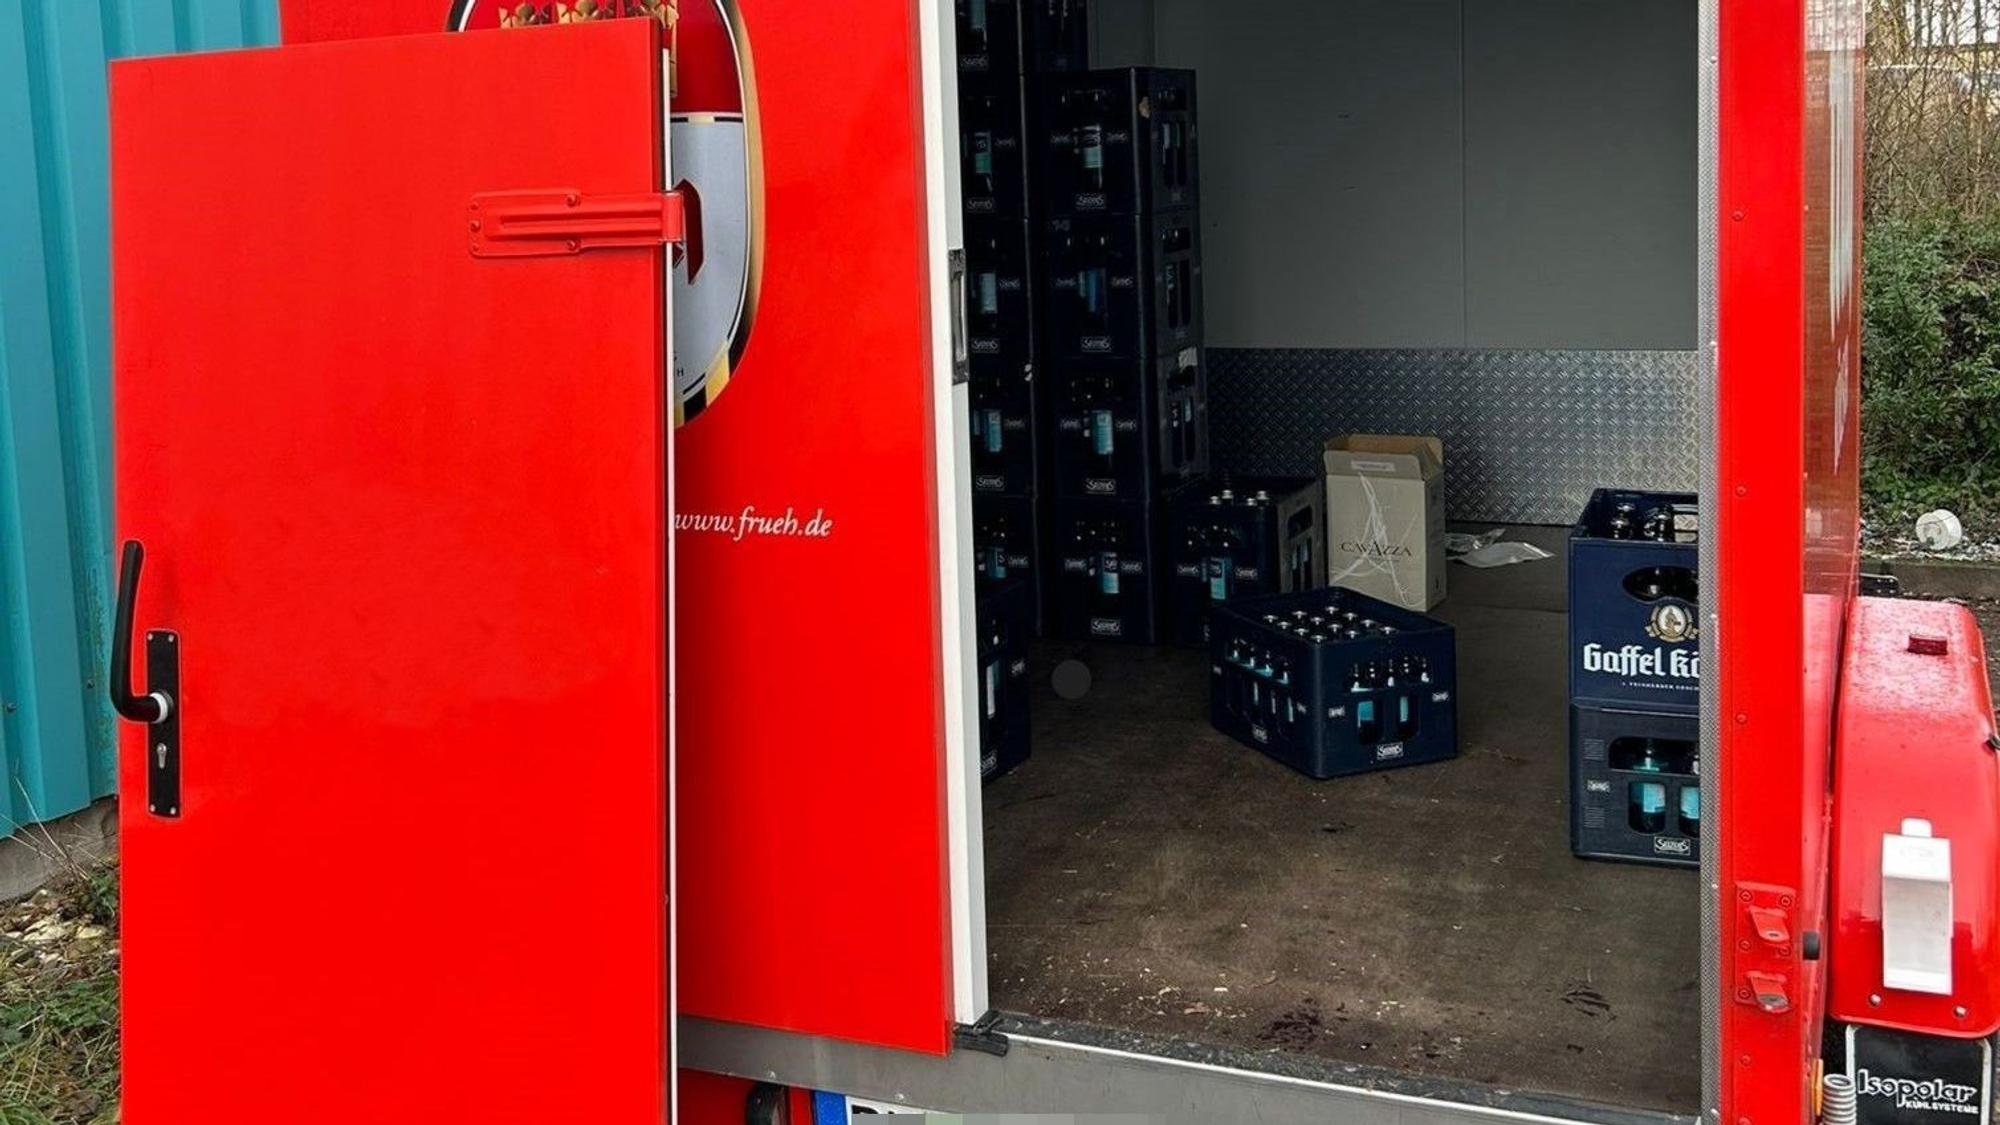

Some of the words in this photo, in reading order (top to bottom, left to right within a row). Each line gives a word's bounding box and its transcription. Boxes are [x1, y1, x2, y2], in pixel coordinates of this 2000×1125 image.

[675, 505, 832, 541] www.frueh.de
[1583, 642, 1666, 677] Gaffel
[1857, 1068, 1977, 1108] Isopolar
